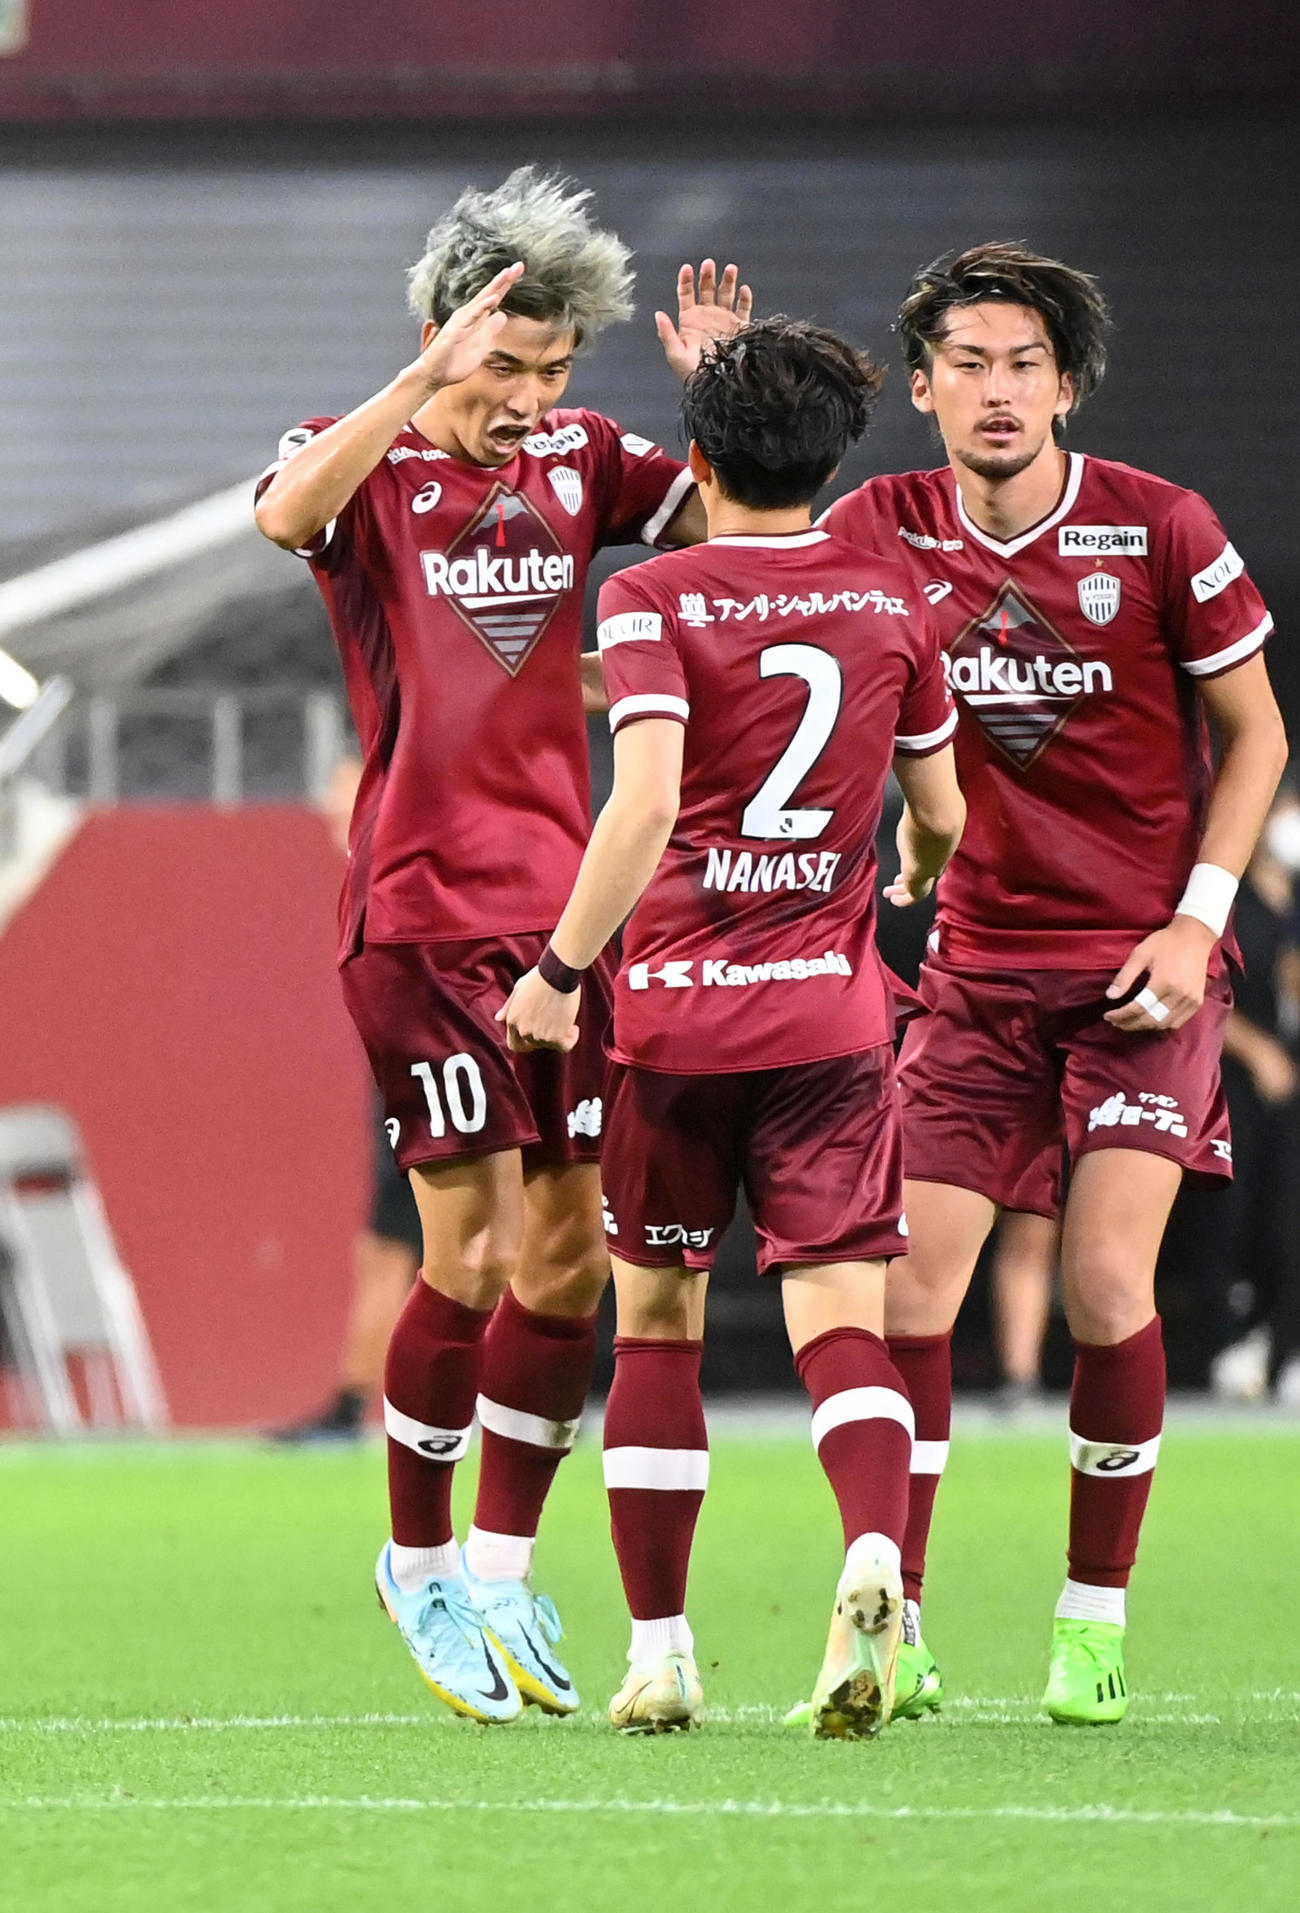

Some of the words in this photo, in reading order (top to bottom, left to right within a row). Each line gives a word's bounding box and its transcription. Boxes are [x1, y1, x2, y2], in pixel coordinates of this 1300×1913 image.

[1063, 530, 1144, 551] Regain
[422, 548, 574, 596] Rakuten
[740, 641, 842, 840] 2
[702, 848, 842, 893] NANASEI
[702, 951, 853, 987] Kawasaki
[410, 1052, 487, 1138] 10
